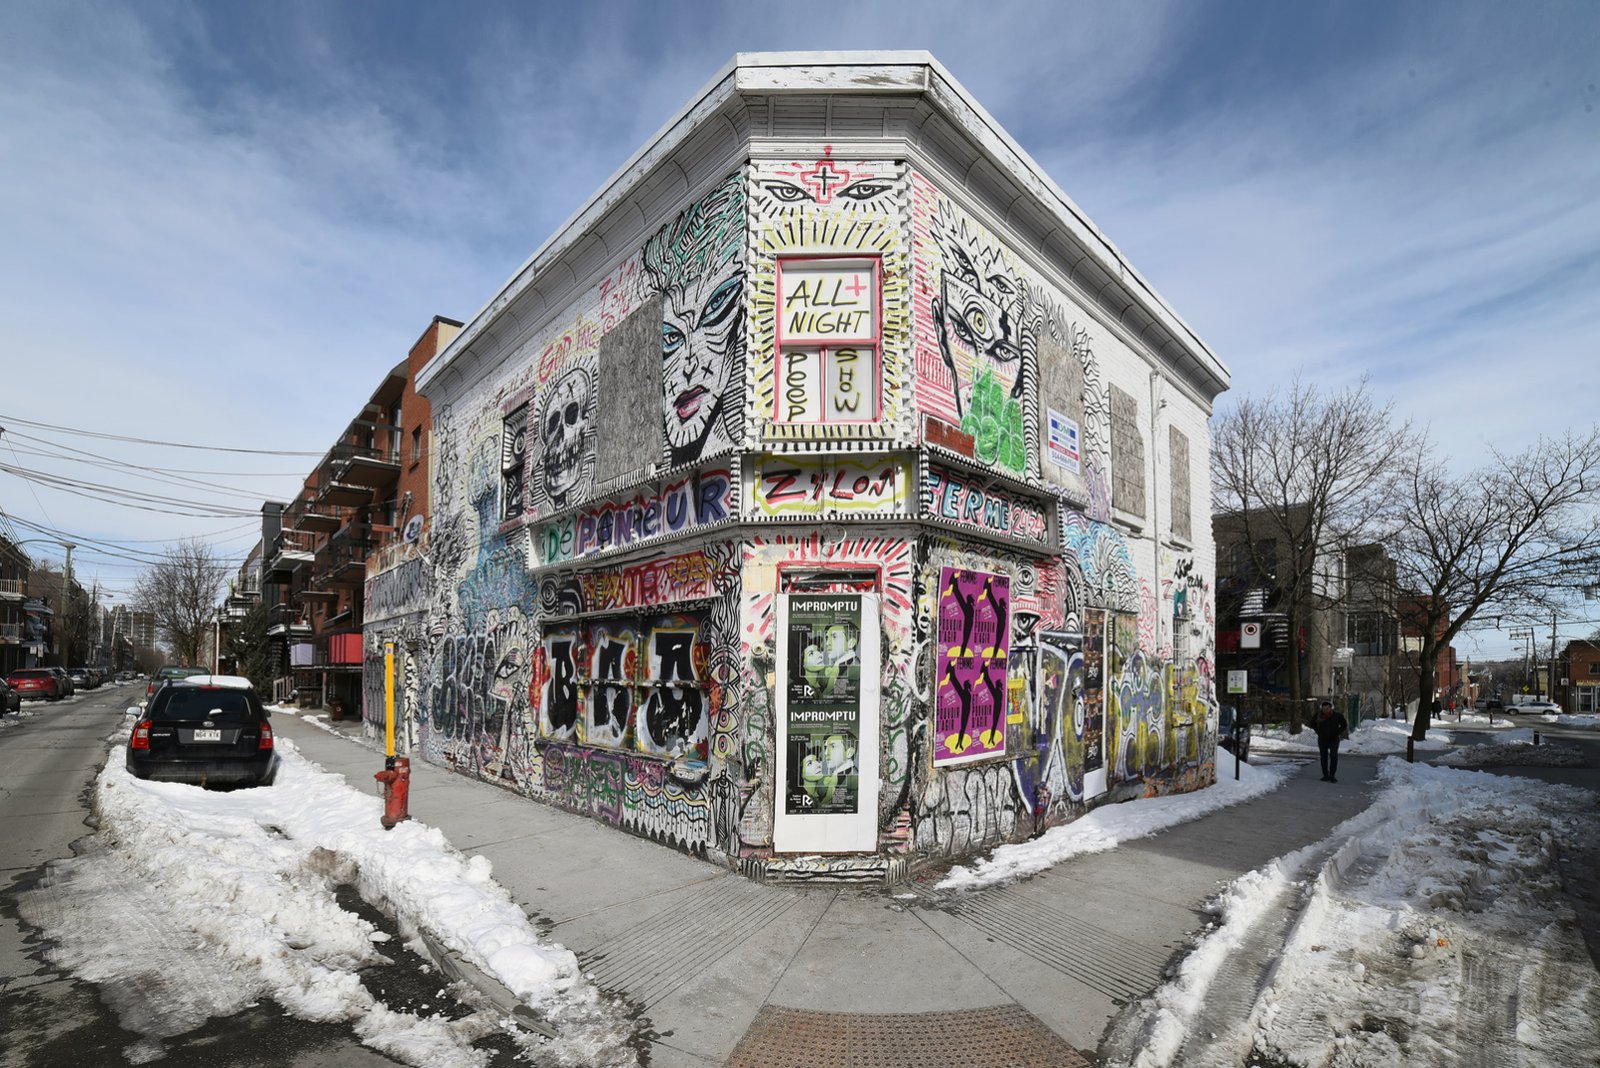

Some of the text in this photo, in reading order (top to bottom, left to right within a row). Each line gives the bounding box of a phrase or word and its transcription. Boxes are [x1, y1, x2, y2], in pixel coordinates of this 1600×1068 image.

[786, 279, 858, 308] ALL
[789, 310, 870, 334] NIGHT
[834, 348, 860, 413] SHOW
[792, 601, 858, 612] IMPROMPTU
[790, 711, 856, 722] IMPROMPTU
